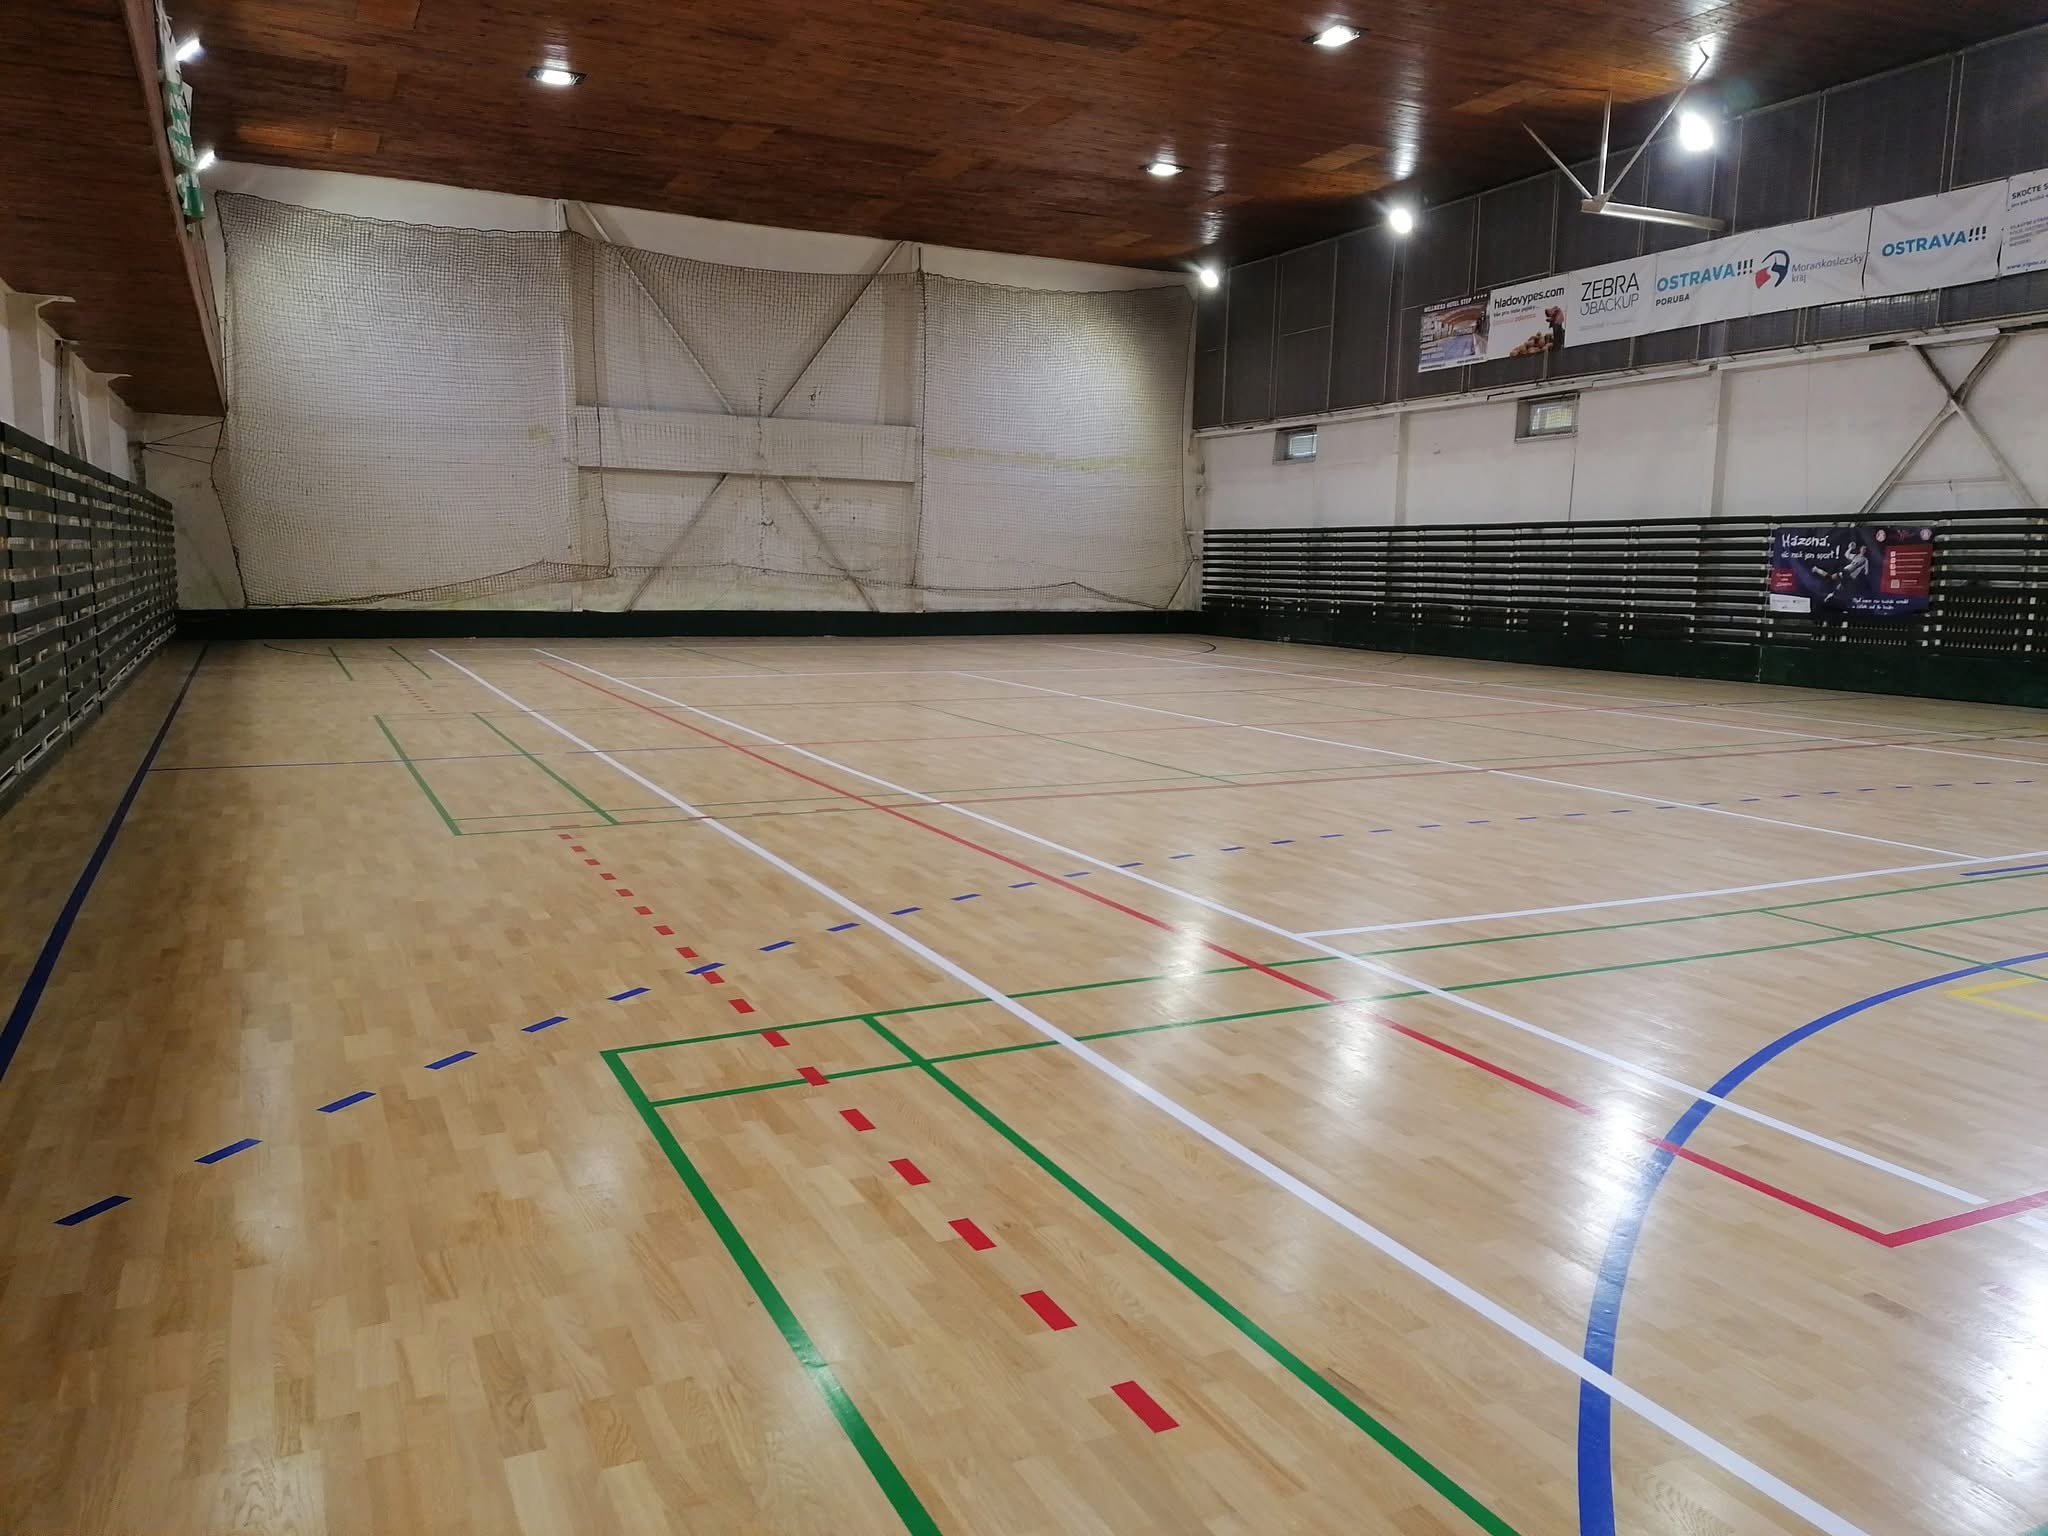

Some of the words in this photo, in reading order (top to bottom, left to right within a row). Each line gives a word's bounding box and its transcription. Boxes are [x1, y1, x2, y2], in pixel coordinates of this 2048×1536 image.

[1882, 226, 1987, 257] OSTRAVA!!!
[1581, 272, 1640, 302] ZEBRA
[1656, 259, 1753, 292] OSTRAVA!!!
[1791, 273, 1807, 284] kraj
[1494, 287, 1565, 309] hladovypes.com
[1655, 293, 1690, 306] PORUBA
